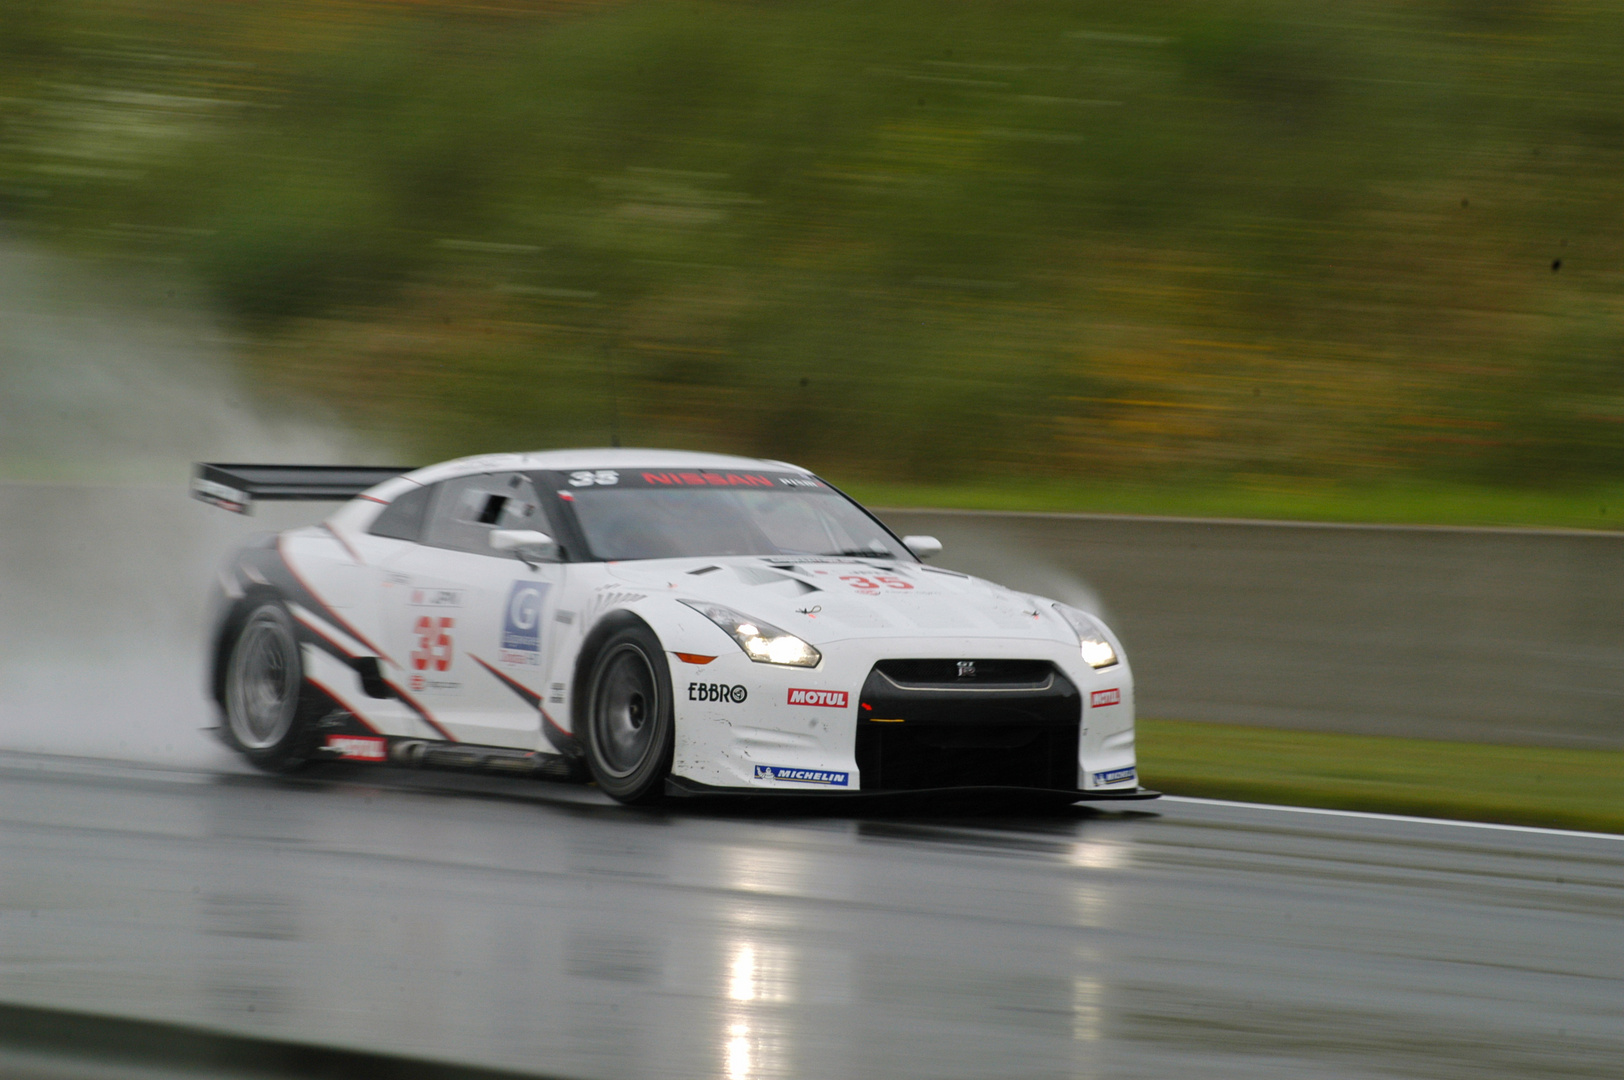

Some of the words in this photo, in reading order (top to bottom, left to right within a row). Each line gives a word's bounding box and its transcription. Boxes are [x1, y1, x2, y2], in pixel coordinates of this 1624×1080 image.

[568, 470, 619, 487] 35
[641, 471, 775, 487] NISSAN
[838, 575, 915, 590] 35
[510, 587, 543, 631] G
[410, 615, 457, 672] 35
[688, 682, 748, 704] EBBRO
[789, 690, 846, 706] MOTUL
[777, 769, 845, 783] MICHELIN
